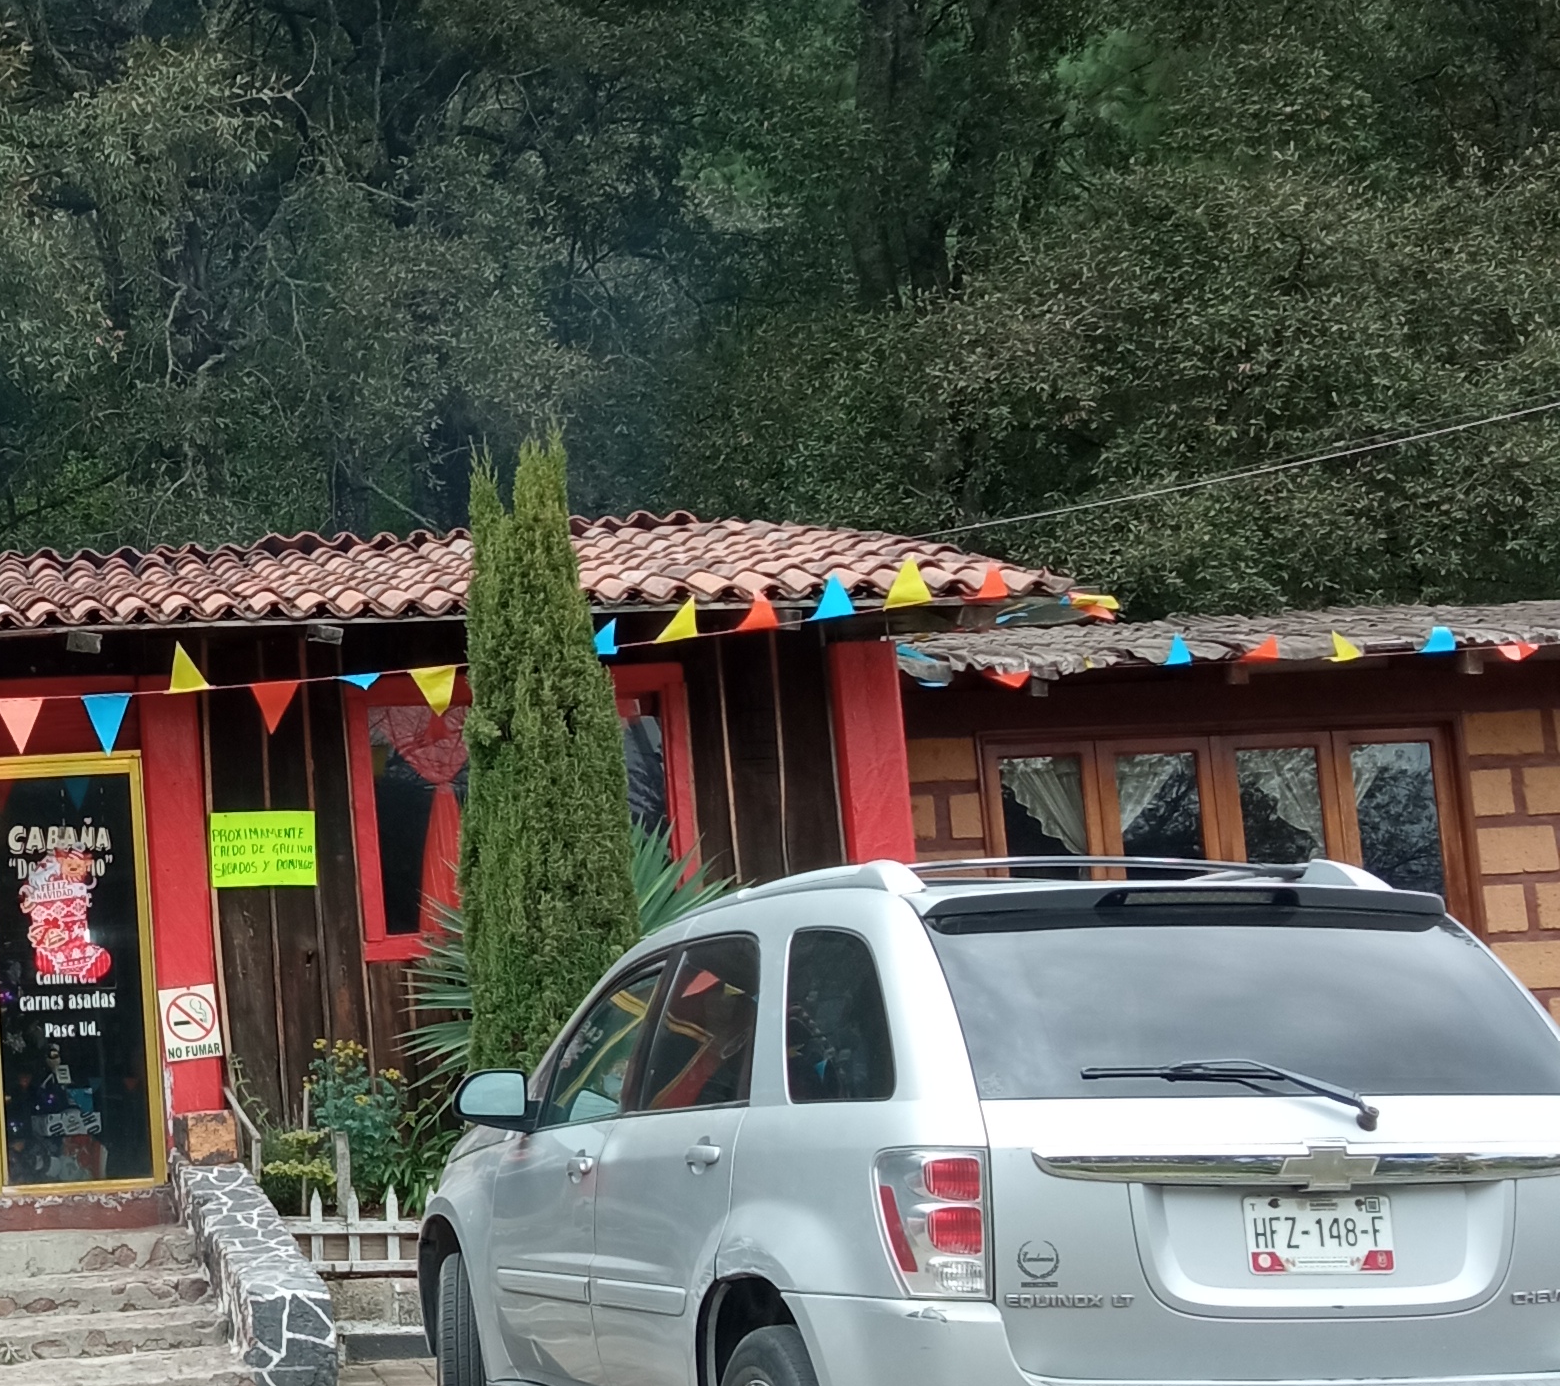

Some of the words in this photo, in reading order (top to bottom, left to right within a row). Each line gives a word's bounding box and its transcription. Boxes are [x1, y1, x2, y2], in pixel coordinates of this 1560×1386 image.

[8, 817, 111, 854] CABAÑA
[212, 827, 304, 843] PROXIMAMENTE
[214, 845, 246, 857] CALDO
[252, 844, 265, 854] DE
[272, 843, 313, 856] GALLINA
[262, 860, 271, 872] Y
[36, 888, 74, 900] NAVIDAD
[41, 881, 67, 892] FELIZ
[20, 995, 64, 1011] carnes
[68, 991, 116, 1009] asadas
[45, 1023, 75, 1037] Pase
[168, 1047, 182, 1059] NO
[186, 1043, 220, 1057] FUMAR
[1253, 1216, 1384, 1249] HFZ-148-F
[1005, 1294, 1104, 1309] EQUINOX
[1111, 1294, 1135, 1308] LT
